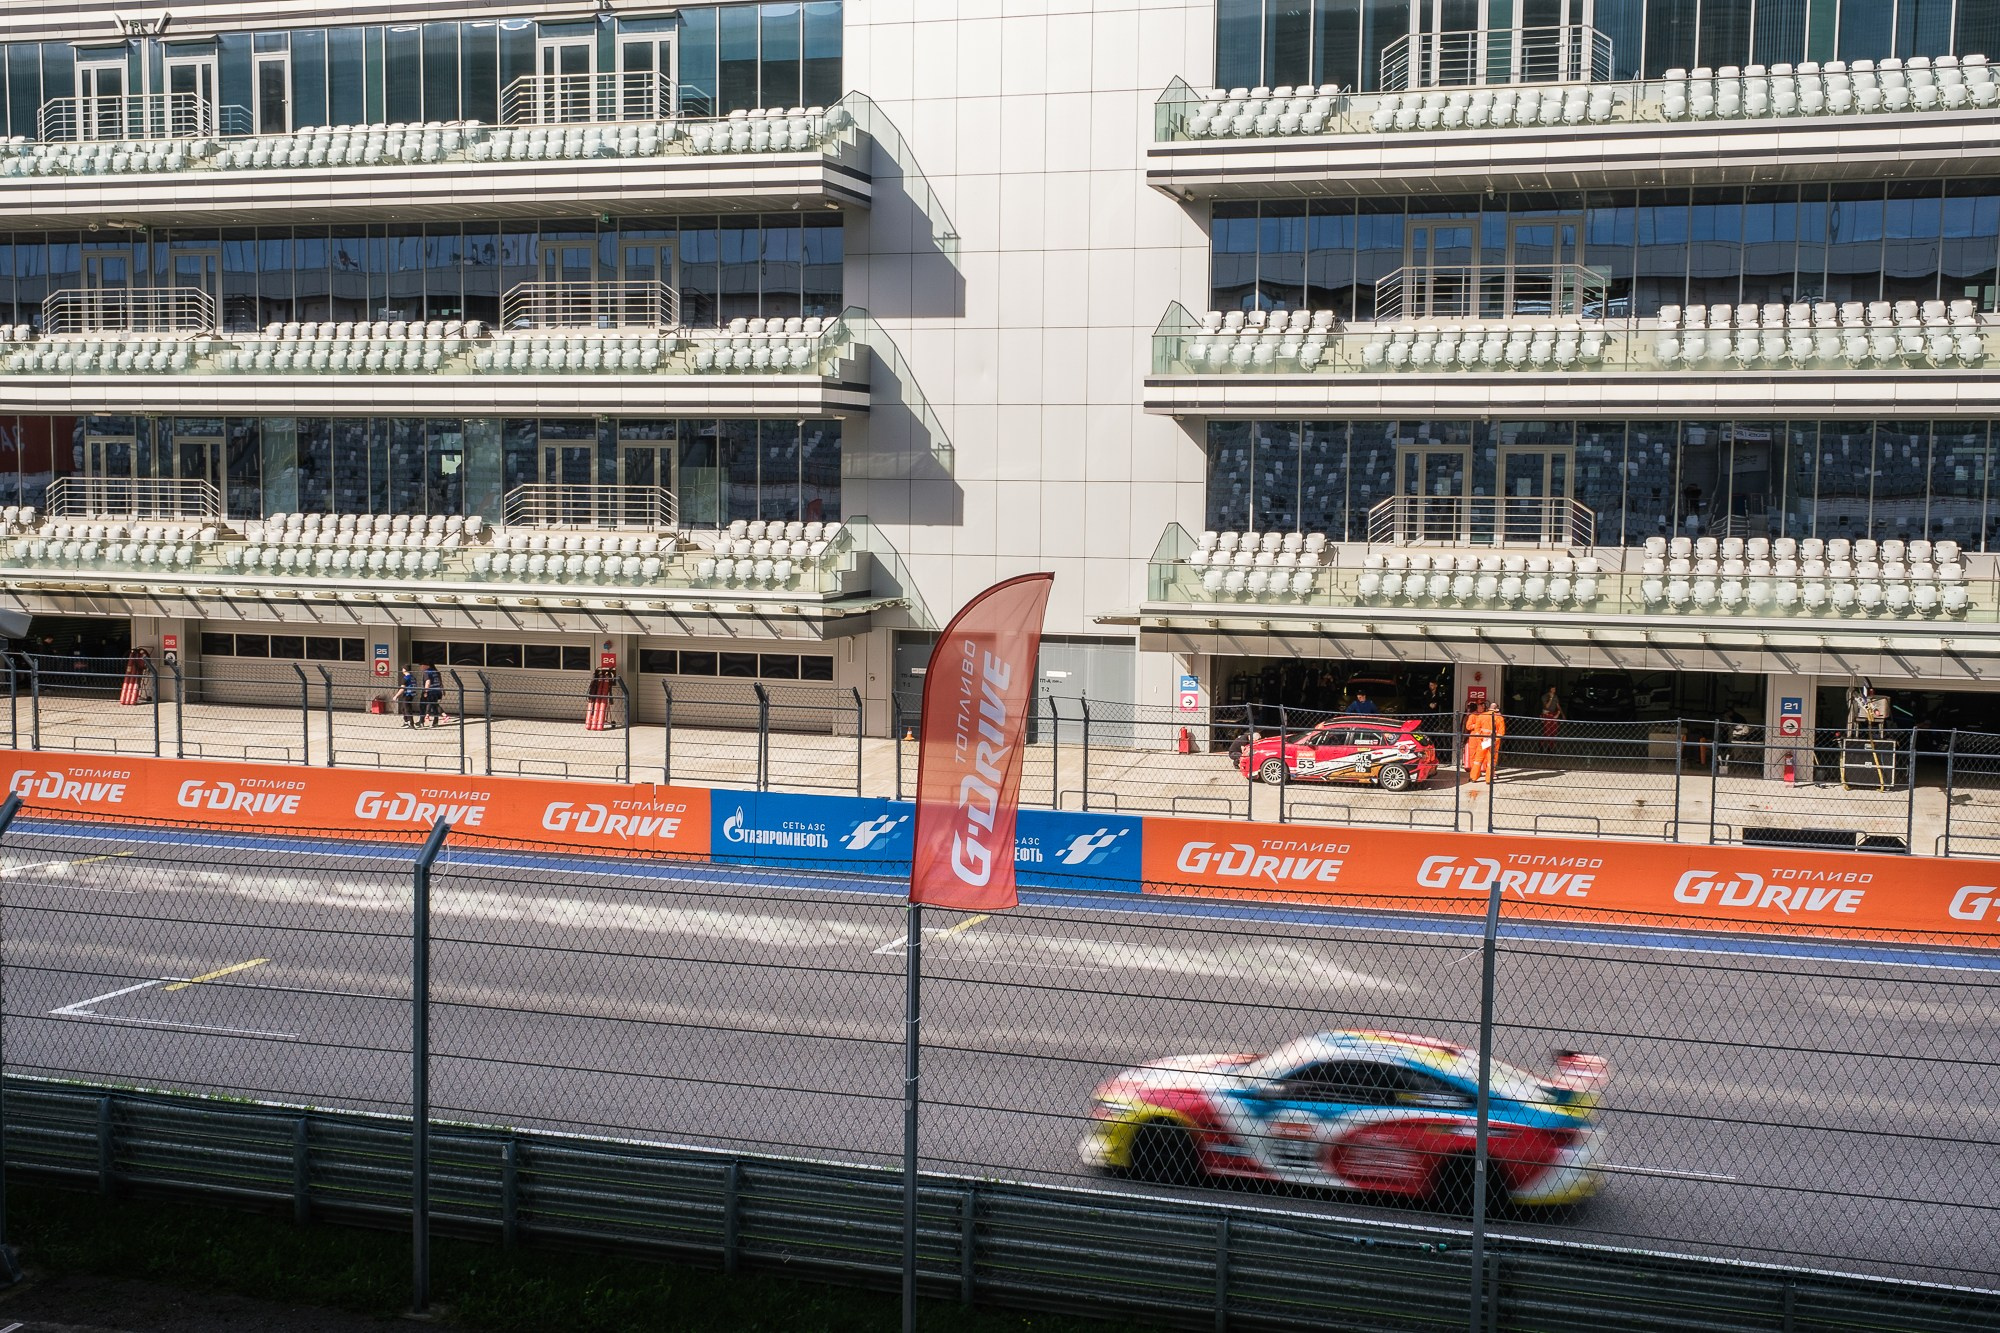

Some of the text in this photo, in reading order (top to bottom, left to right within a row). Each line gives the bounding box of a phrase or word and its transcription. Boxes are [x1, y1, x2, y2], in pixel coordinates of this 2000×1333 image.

[1182, 680, 1196, 688] 23
[1470, 691, 1485, 699] 22
[955, 639, 977, 764] ТОПЛИВО
[1783, 702, 1799, 710] 21
[1298, 760, 1315, 769] 53
[68, 767, 131, 779] ТОПЛИВО
[239, 778, 306, 790] ТОПЛИВО
[421, 788, 491, 801] ТОПЛИВО
[612, 800, 687, 813] ТОПЛИВО
[782, 821, 826, 832] СЕТЬ АЗС
[744, 828, 829, 848] ГАЗПРОМНЕФТЬ
[1021, 836, 1040, 846] АЗС
[1261, 839, 1351, 854] ТОПЛИВО
[1507, 853, 1603, 869] ТОПЛИВО
[1771, 868, 1874, 883] ТОПЛИВО
